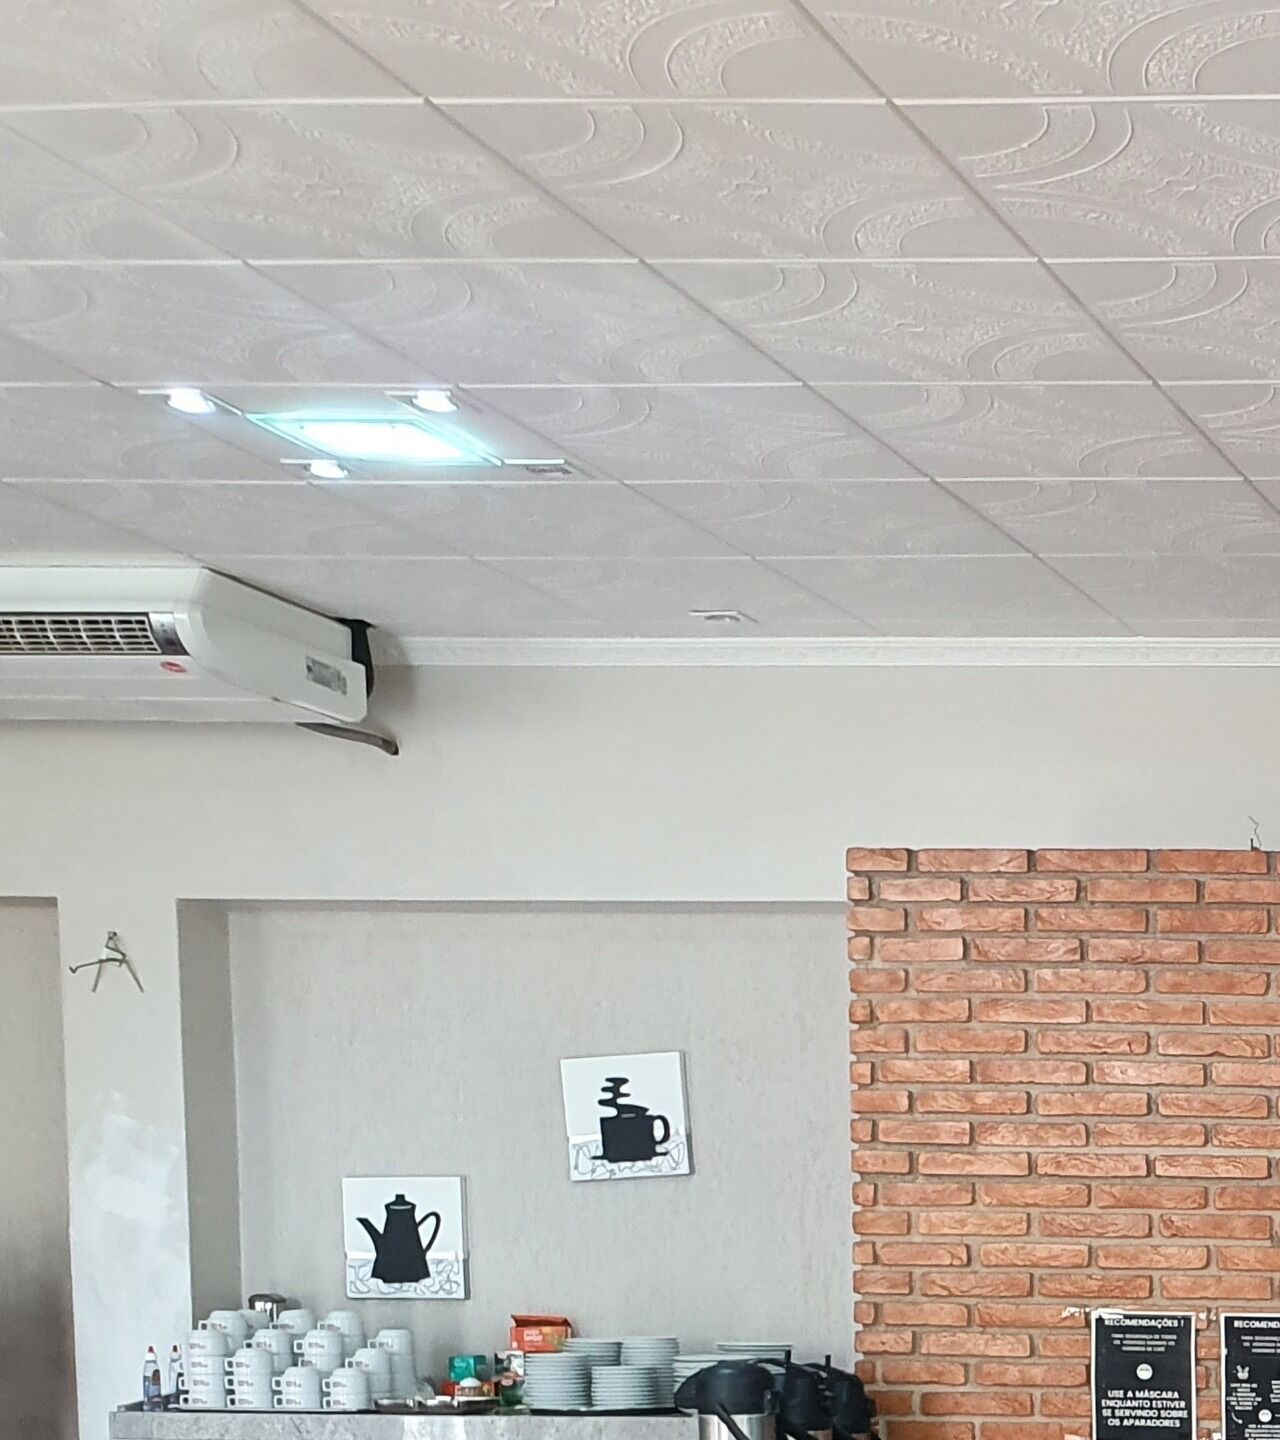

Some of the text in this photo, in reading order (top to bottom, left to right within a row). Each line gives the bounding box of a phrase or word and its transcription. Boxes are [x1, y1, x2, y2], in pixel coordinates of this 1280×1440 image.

[1103, 1318, 1179, 1329] RECOMENDAÇÕES
[1107, 1388, 1180, 1399] USE A MÁSCARA
[1101, 1399, 1186, 1409] ENQUANTO ESTIVER
[1101, 1408, 1189, 1419] SE SERVINDO SOBRE
[1107, 1418, 1181, 1428] OS APARADORES
